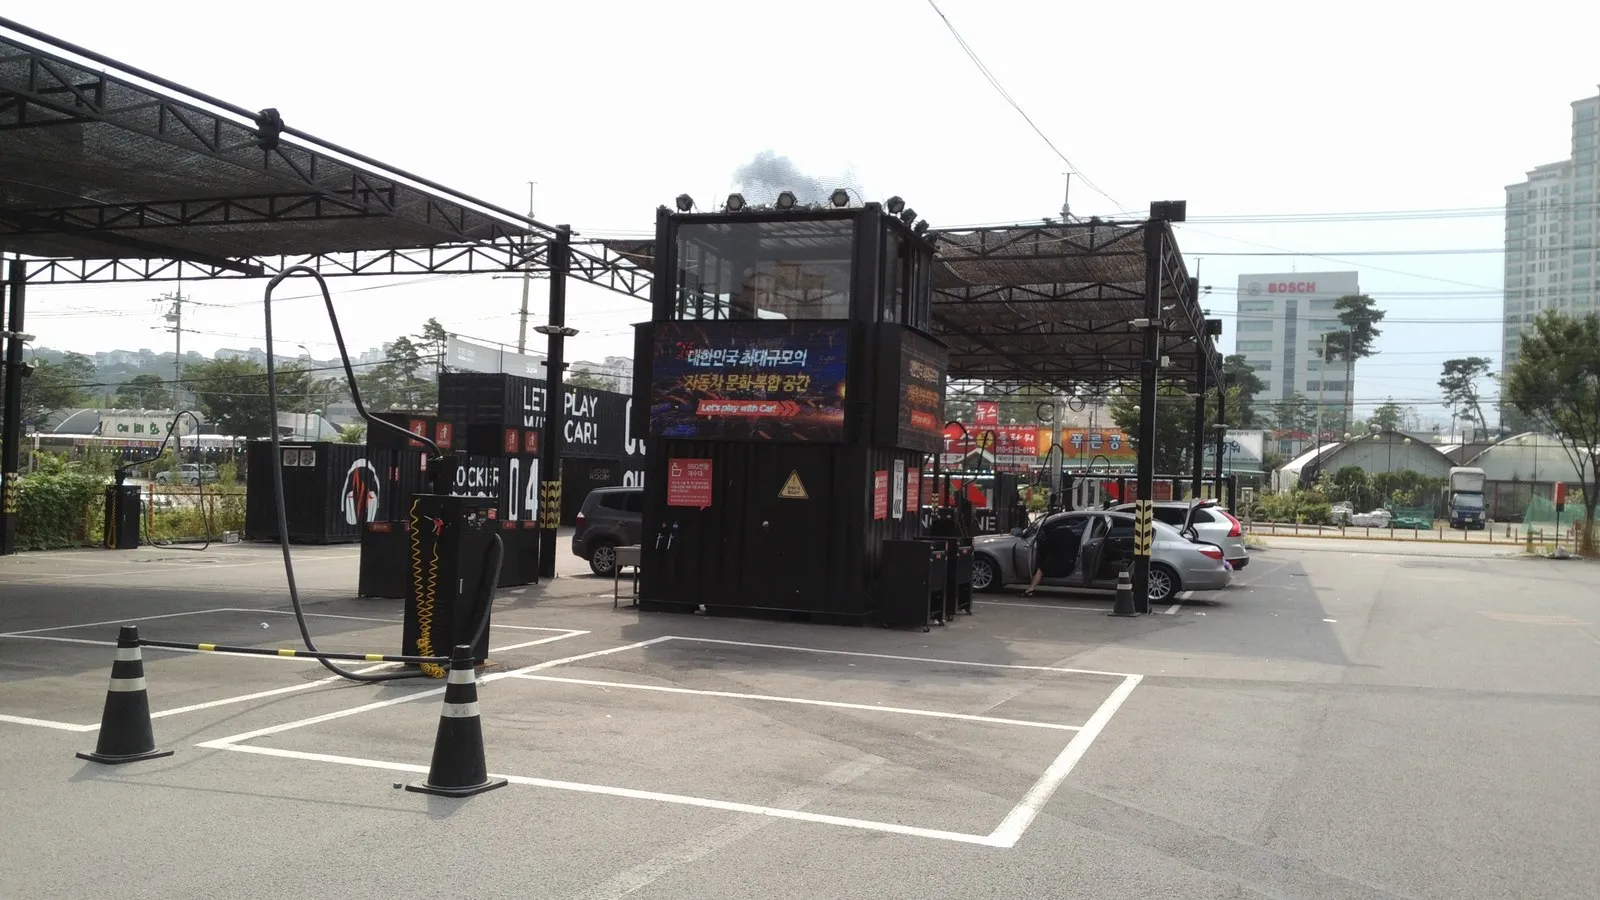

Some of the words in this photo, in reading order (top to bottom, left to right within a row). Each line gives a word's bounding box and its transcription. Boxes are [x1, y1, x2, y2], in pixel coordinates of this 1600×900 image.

[1268, 282, 1316, 293] BOSCH
[687, 348, 740, 367] 대한민국
[740, 348, 808, 367] 최대규모의
[684, 374, 723, 391] 자동차
[783, 373, 810, 392] 공간
[523, 385, 548, 413] LET
[564, 391, 598, 418] PLAY
[701, 403, 720, 413] Let's
[720, 404, 738, 414] play
[740, 403, 758, 413] with
[975, 404, 997, 420] 뉴스
[564, 419, 598, 445] CAR!
[1070, 433, 1139, 451] 푸른공
[452, 465, 500, 487] OCKER
[588, 473, 611, 481] ROOM
[508, 457, 539, 521] 04
